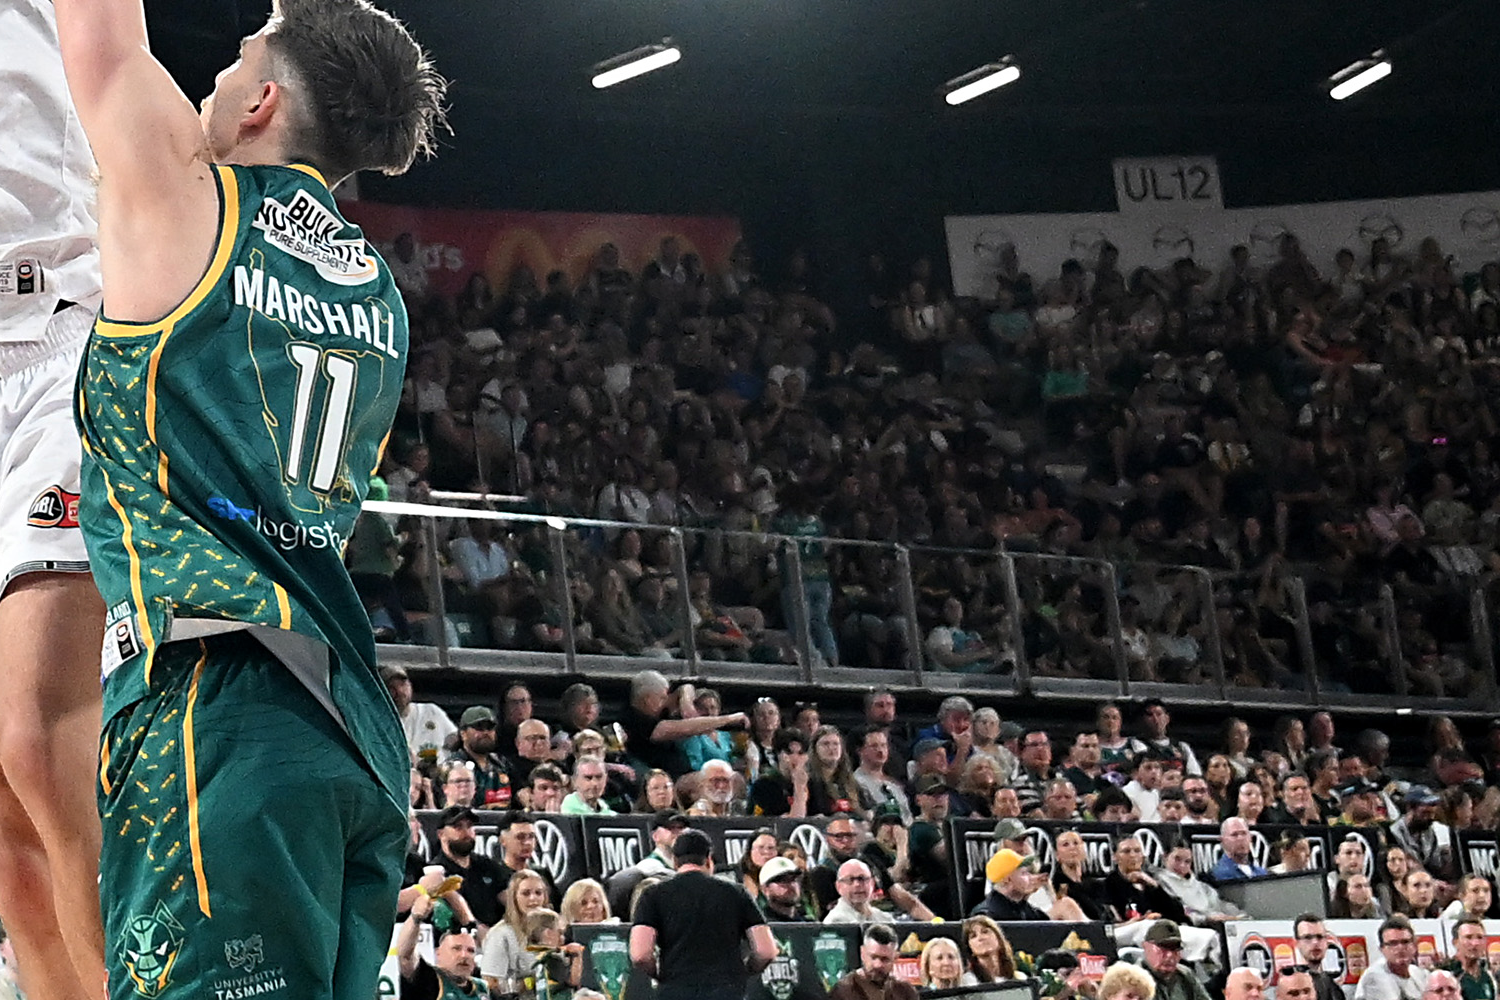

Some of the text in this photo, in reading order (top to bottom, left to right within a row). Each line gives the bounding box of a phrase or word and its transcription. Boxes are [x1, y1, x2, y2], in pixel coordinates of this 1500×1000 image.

[1123, 165, 1210, 202] UL12
[289, 196, 339, 244] BULK
[269, 229, 295, 248] PURE
[294, 242, 350, 273] SUPPLEMENTS
[233, 264, 400, 359] MARSHALL
[286, 343, 357, 495] 11
[214, 969, 276, 989] UNIVERSITY
[890, 962, 919, 980] AMES
[215, 977, 287, 1000] TASMANIA
